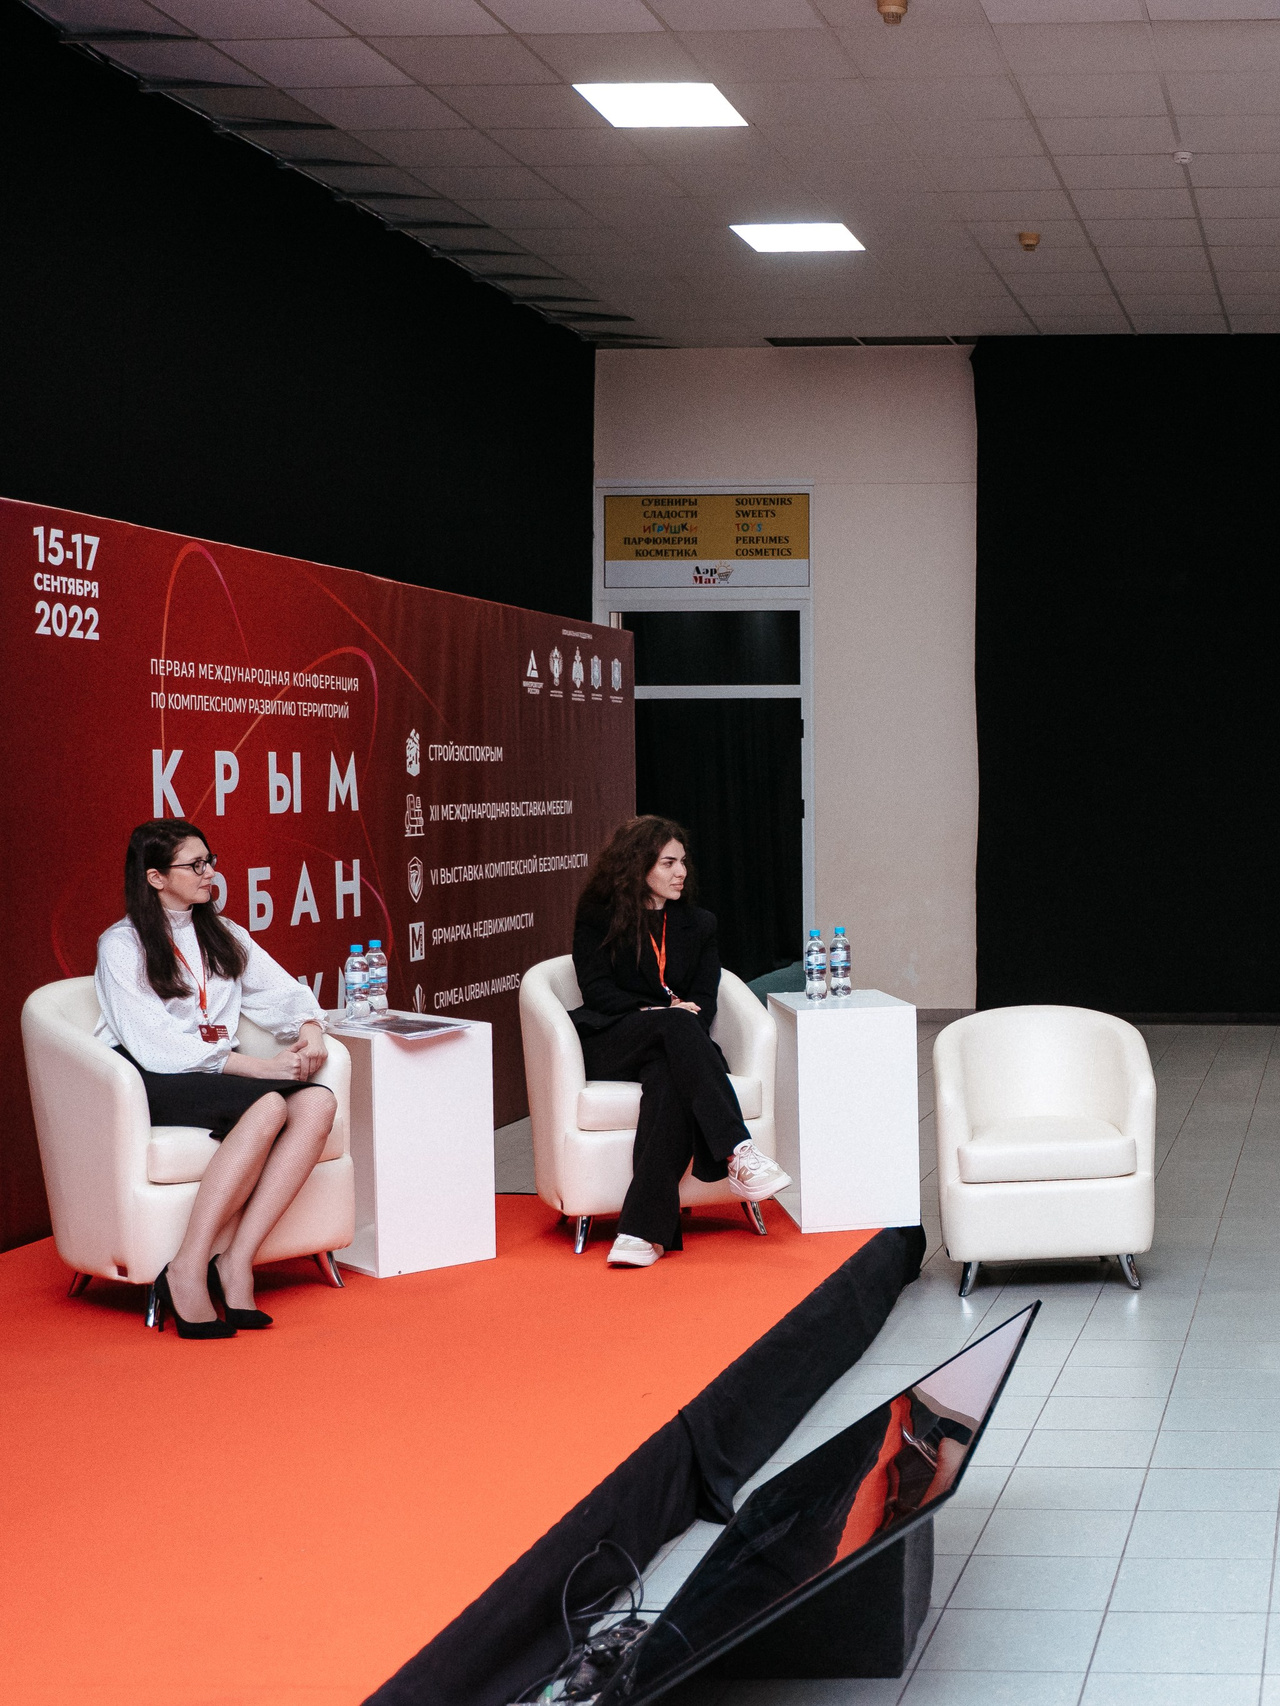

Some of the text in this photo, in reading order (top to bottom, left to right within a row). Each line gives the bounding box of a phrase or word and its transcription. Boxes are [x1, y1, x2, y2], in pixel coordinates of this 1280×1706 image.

[641, 498, 698, 507] СУВЕНИРЫ
[735, 497, 793, 506] SOUVENIRS
[643, 510, 698, 519] СЛАДОСТИ
[735, 509, 776, 518] SWEETS
[735, 522, 763, 532] TOYS
[33, 526, 100, 571] 15-17
[623, 536, 698, 545] ПАРФЮМЕРИЯ
[735, 535, 790, 545] PERFUMES
[635, 548, 698, 557] КОСМЕТИКА
[735, 547, 792, 557] COSMETICS
[33, 572, 99, 598] СЕНТЯБРЯ
[35, 600, 100, 641] 2022
[150, 658, 359, 693] ПЕРВАЯ МЕЖДУНАРОДНАЯ КОНФЕРЕНЦИЯ
[151, 692, 350, 719] ПО КОМПЛЕКСНОМУ РАЗВИТИЮ ТЕРРИТОРИЙ
[428, 741, 503, 762] СТРОЙЭКСПОКРЫМ
[152, 749, 359, 818] КРЫМ
[429, 800, 573, 823] XII МЕЖДУНАРОДНАЯ ВЫСТАВКА МЕБЕЛИ
[430, 853, 589, 886] VI ВЫСТАВКА КОМПЛЕКСНОЙ БЕЗОПАСНОСТИ
[431, 912, 534, 946] ЯРМАРКА НЕДВИЖИМОСТИ
[434, 973, 521, 1010] CRIMEA URBAN AWARDS
